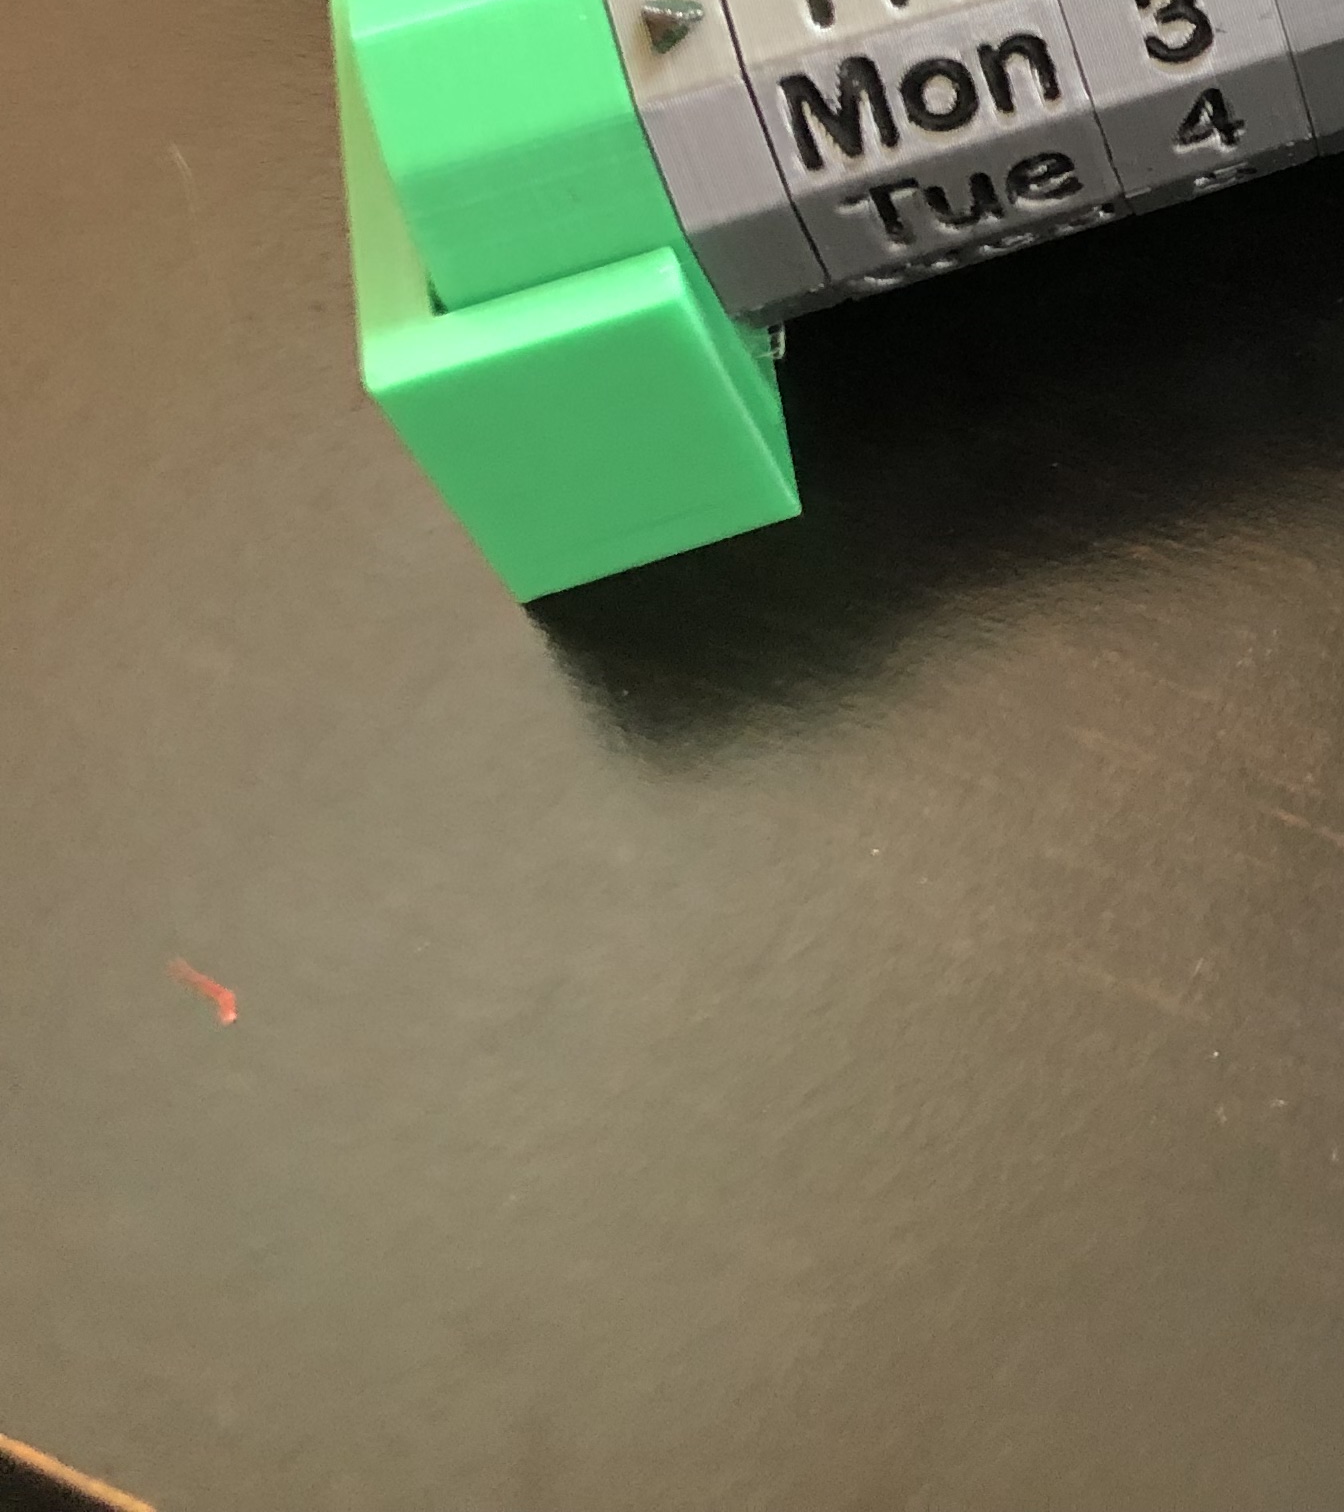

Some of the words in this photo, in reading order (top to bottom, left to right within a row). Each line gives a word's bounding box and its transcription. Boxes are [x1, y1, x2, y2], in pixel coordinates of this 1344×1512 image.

[779, 23, 1061, 173] Mon
[842, 147, 1085, 246] Tue
[1172, 86, 1247, 154] 4
